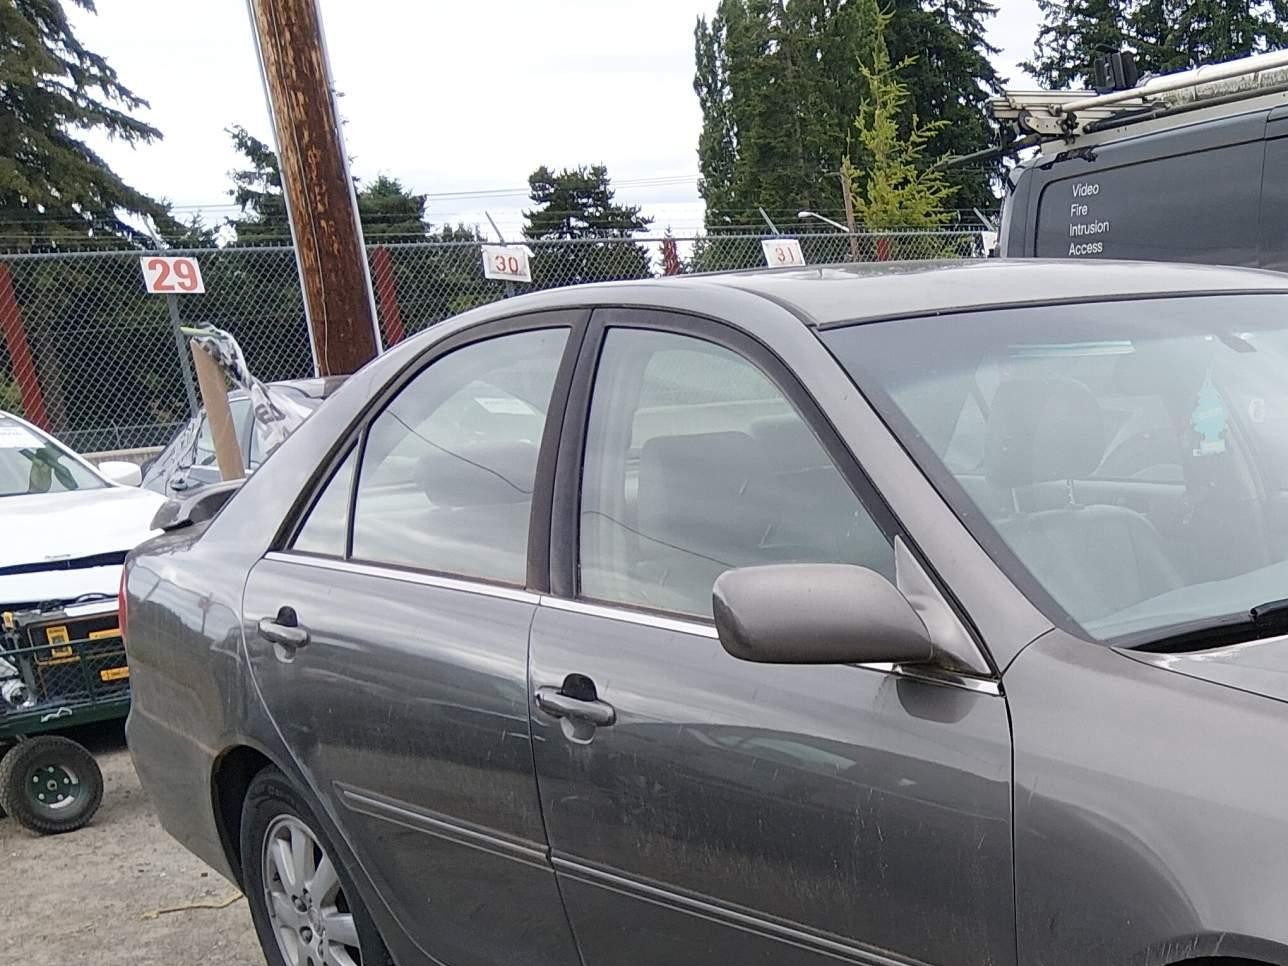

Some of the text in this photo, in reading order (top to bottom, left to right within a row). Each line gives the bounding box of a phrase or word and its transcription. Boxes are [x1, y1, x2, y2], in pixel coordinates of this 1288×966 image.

[1072, 183, 1100, 198] Video
[1070, 203, 1089, 217] Fire
[1069, 219, 1110, 237] Intrusion
[775, 247, 795, 263] 31
[1068, 242, 1103, 257] Access
[494, 255, 519, 274] 30
[147, 258, 199, 292] 29
